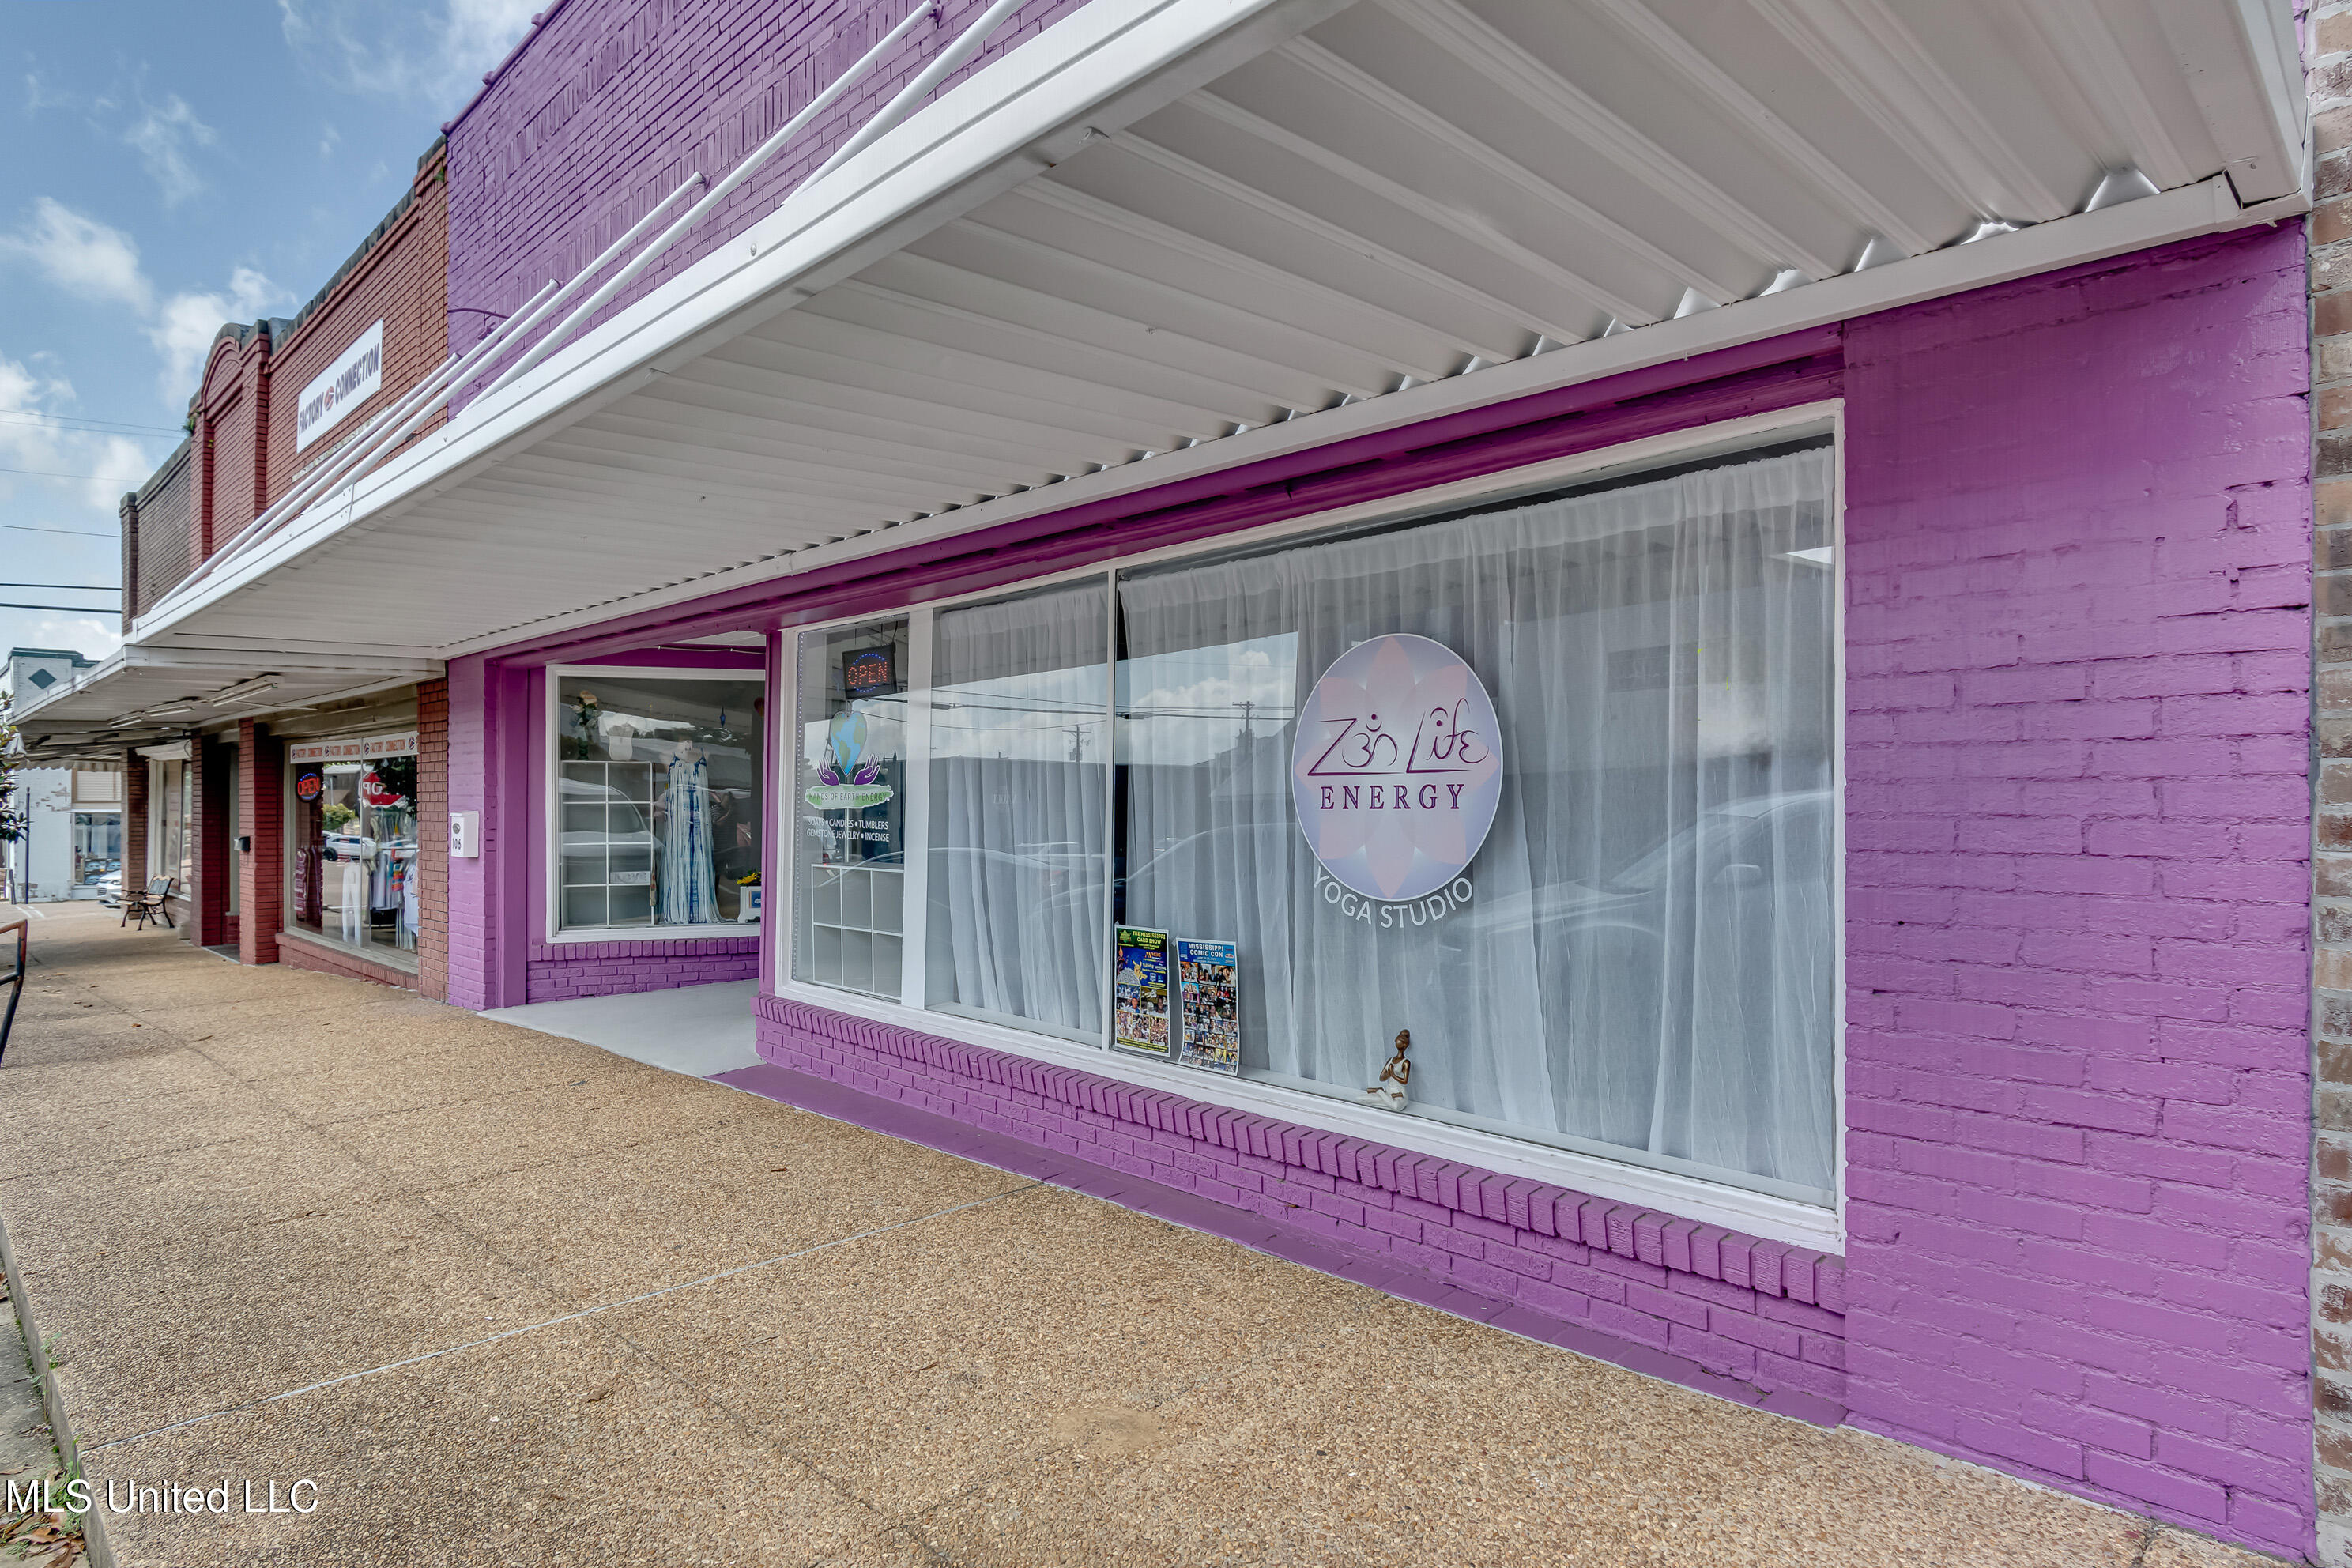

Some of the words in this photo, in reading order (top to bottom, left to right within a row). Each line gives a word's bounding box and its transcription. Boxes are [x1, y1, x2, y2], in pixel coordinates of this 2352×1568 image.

[299, 392, 324, 435] FACTORY
[335, 343, 379, 405] CONNECTION
[848, 662, 887, 685] OPEN
[297, 777, 320, 796] OPEN
[808, 792, 828, 801] HANDS
[831, 792, 838, 801] OF
[840, 792, 859, 801] EARTH
[861, 793, 887, 801] ENERGY
[1320, 783, 1464, 810] ENERGY
[829, 819, 854, 827] CANDLES
[858, 820, 888, 830] TUMBLERS
[807, 828, 835, 838] GEMSTONE
[836, 830, 861, 839] JEWELRY
[865, 832, 890, 842] INCENSE
[1314, 866, 1372, 925] YOGA
[1381, 876, 1473, 929] STUDIO
[1188, 943, 1223, 952] MISSISSIPPI
